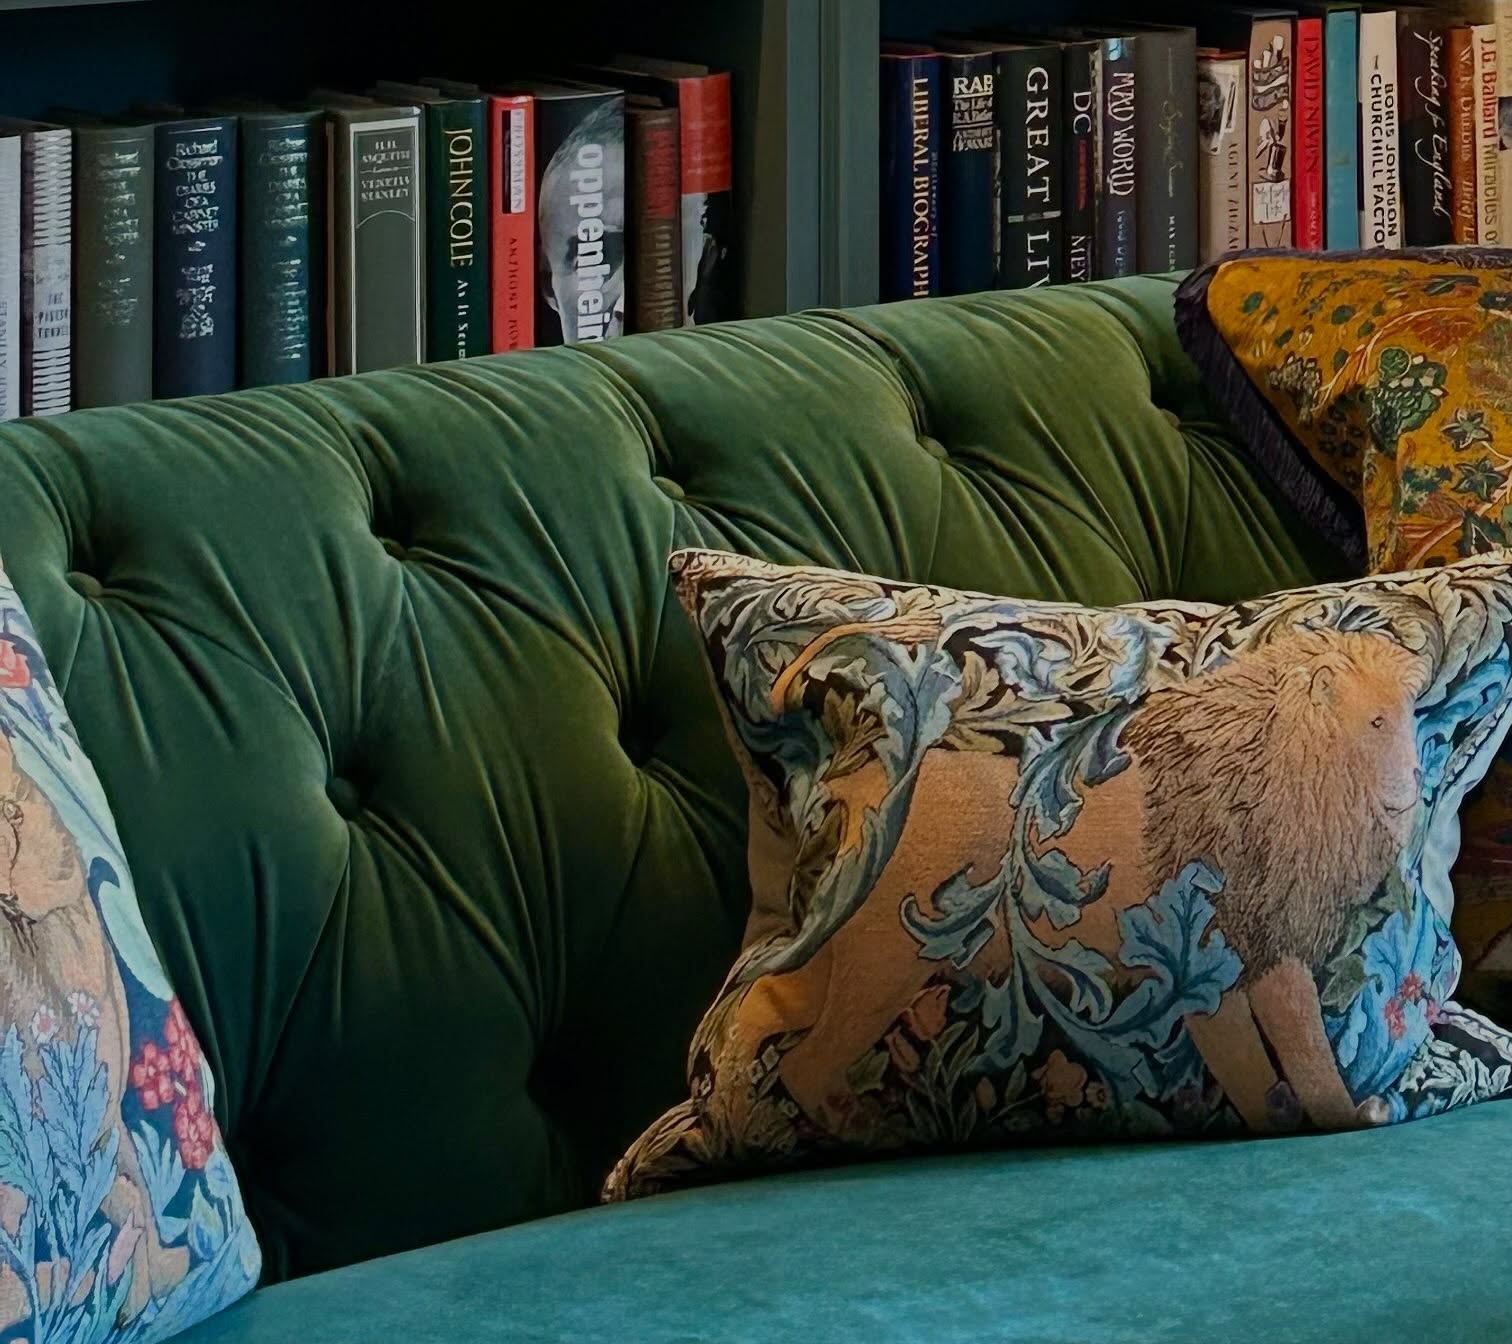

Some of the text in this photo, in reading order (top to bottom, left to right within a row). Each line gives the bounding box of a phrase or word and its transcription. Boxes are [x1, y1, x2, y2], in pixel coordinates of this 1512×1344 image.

[1026, 67, 1050, 204] GREAT
[1072, 91, 1091, 135] DC
[1108, 72, 1135, 196] MAD WORLD
[1371, 73, 1385, 179] CHURCHILL
[1385, 83, 1397, 237] BORIS JOHNSON
[1413, 30, 1451, 218] Speaking England
[1480, 37, 1498, 226] J.G. Ballard Miracles
[444, 128, 474, 268] JOHN COLE
[912, 77, 929, 294] LIBERAL BIOGRAPH
